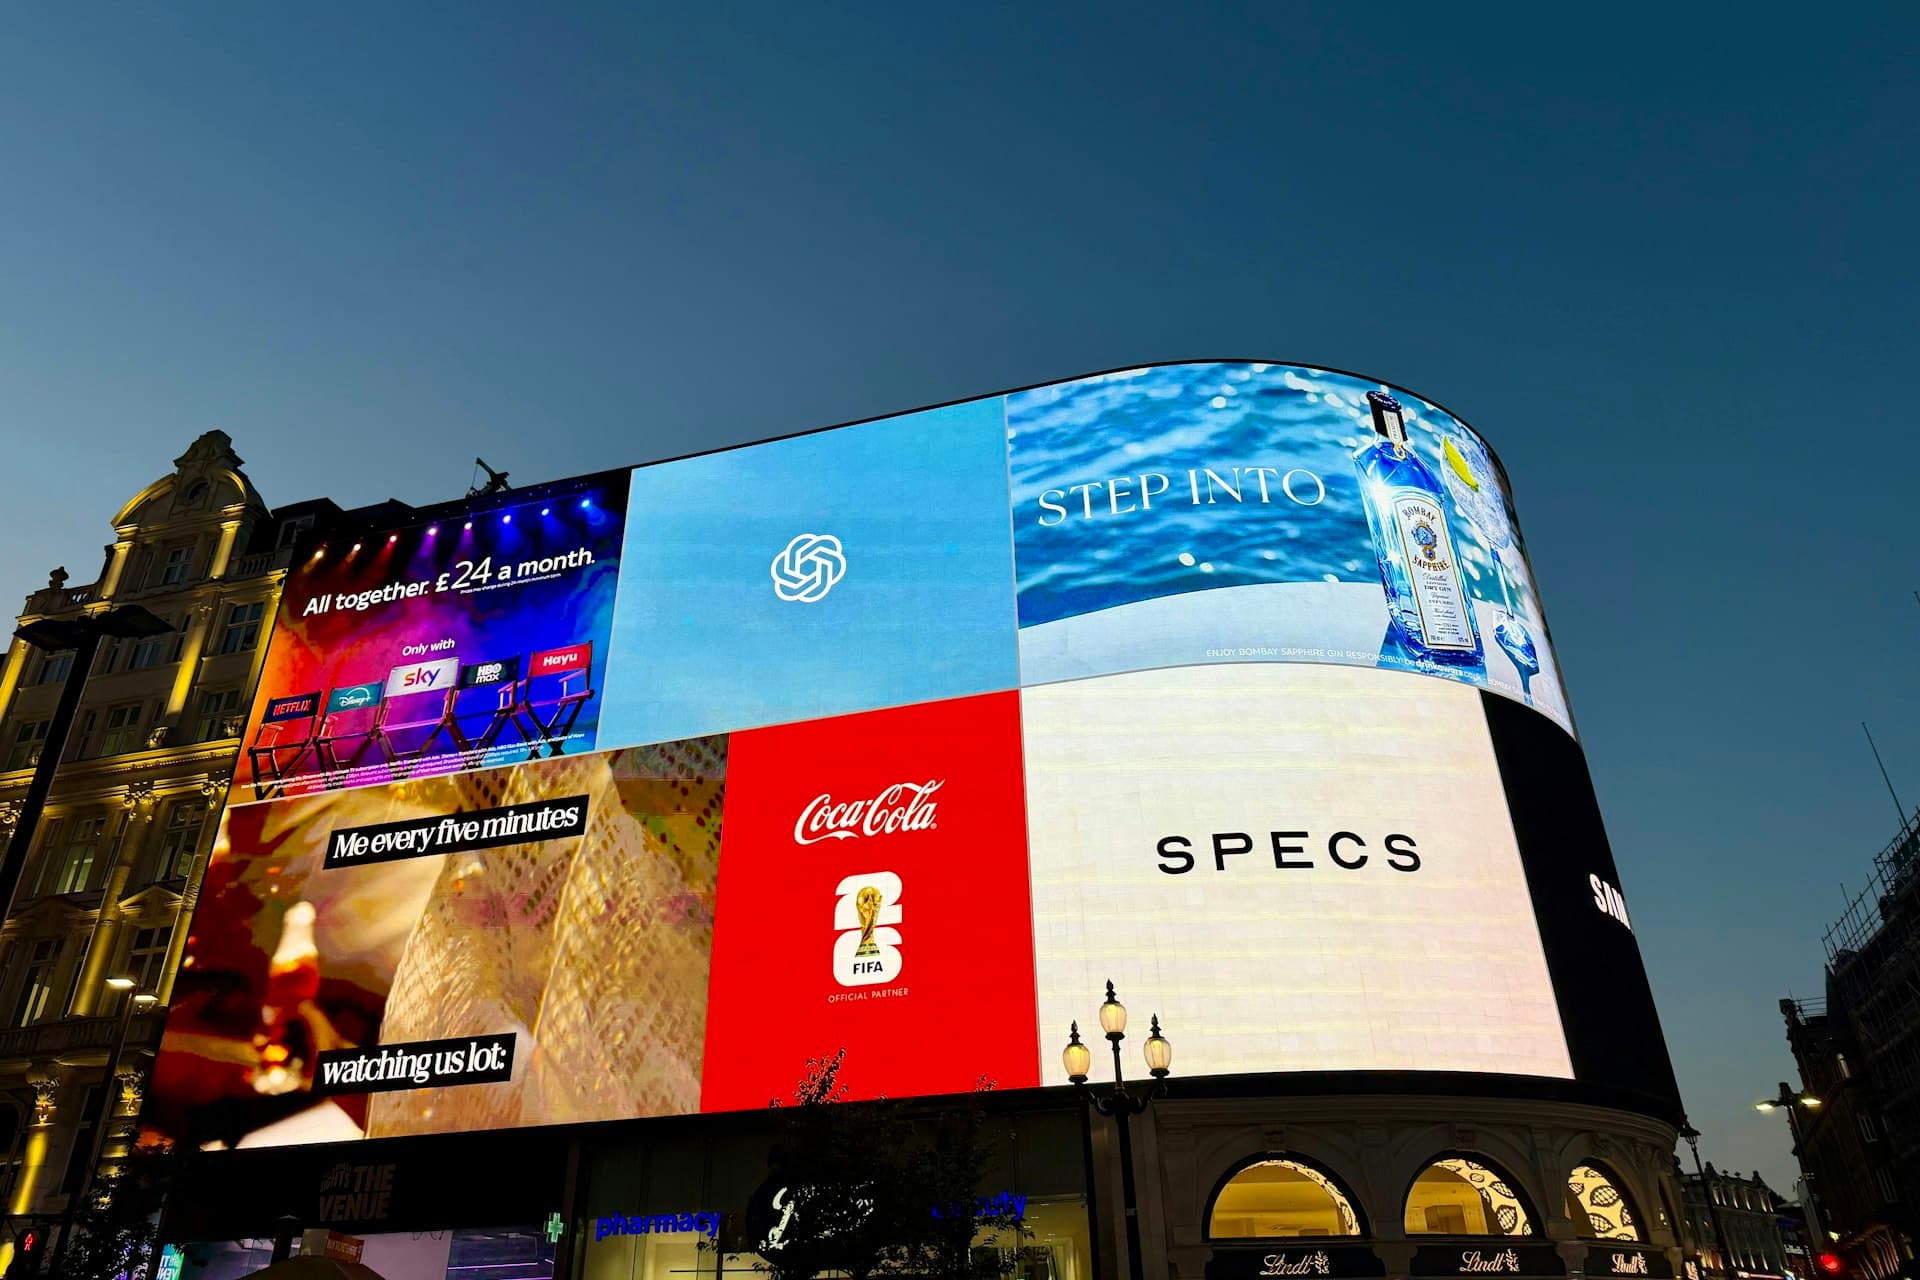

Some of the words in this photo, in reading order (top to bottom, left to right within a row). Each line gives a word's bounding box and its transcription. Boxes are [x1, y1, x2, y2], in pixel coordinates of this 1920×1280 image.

[1037, 472, 1170, 526] STEP
[1190, 466, 1326, 506] INTO
[1402, 505, 1437, 522] BOMBAY
[1412, 554, 1450, 572] SAPPHIRE
[302, 595, 330, 616] All
[335, 580, 429, 611] together.
[435, 556, 493, 593] £24
[498, 565, 511, 581] a
[517, 547, 596, 578] month.
[402, 642, 429, 657] Only
[430, 638, 456, 651] with
[1206, 648, 1236, 657] ENJOY
[1239, 647, 1278, 656] BOMBAY
[1281, 647, 1324, 657] SAPPHIRE
[1327, 649, 1344, 658] GIN
[477, 662, 503, 676] HBO
[543, 652, 578, 667] Hayu
[403, 667, 441, 687] sky
[475, 672, 500, 684] max
[272, 699, 312, 716] NETFLIX
[794, 778, 945, 845] Coca-Cola
[332, 833, 369, 859] Me
[370, 822, 437, 853] every
[436, 816, 478, 846] five
[479, 804, 579, 840] minutes
[1157, 830, 1421, 874] SPECS
[853, 961, 883, 975] FIFA
[828, 991, 868, 1003] OFFICIAL
[871, 987, 909, 999] PARTNER
[322, 1048, 431, 1086] watching
[434, 1050, 464, 1073] us
[467, 1041, 507, 1071] lot:
[352, 1162, 396, 1193] THE
[319, 1192, 388, 1223] VENUE
[595, 1208, 722, 1241] pharmacy
[1259, 1253, 1315, 1275] Lindt
[1459, 1250, 1507, 1273] Lindt
